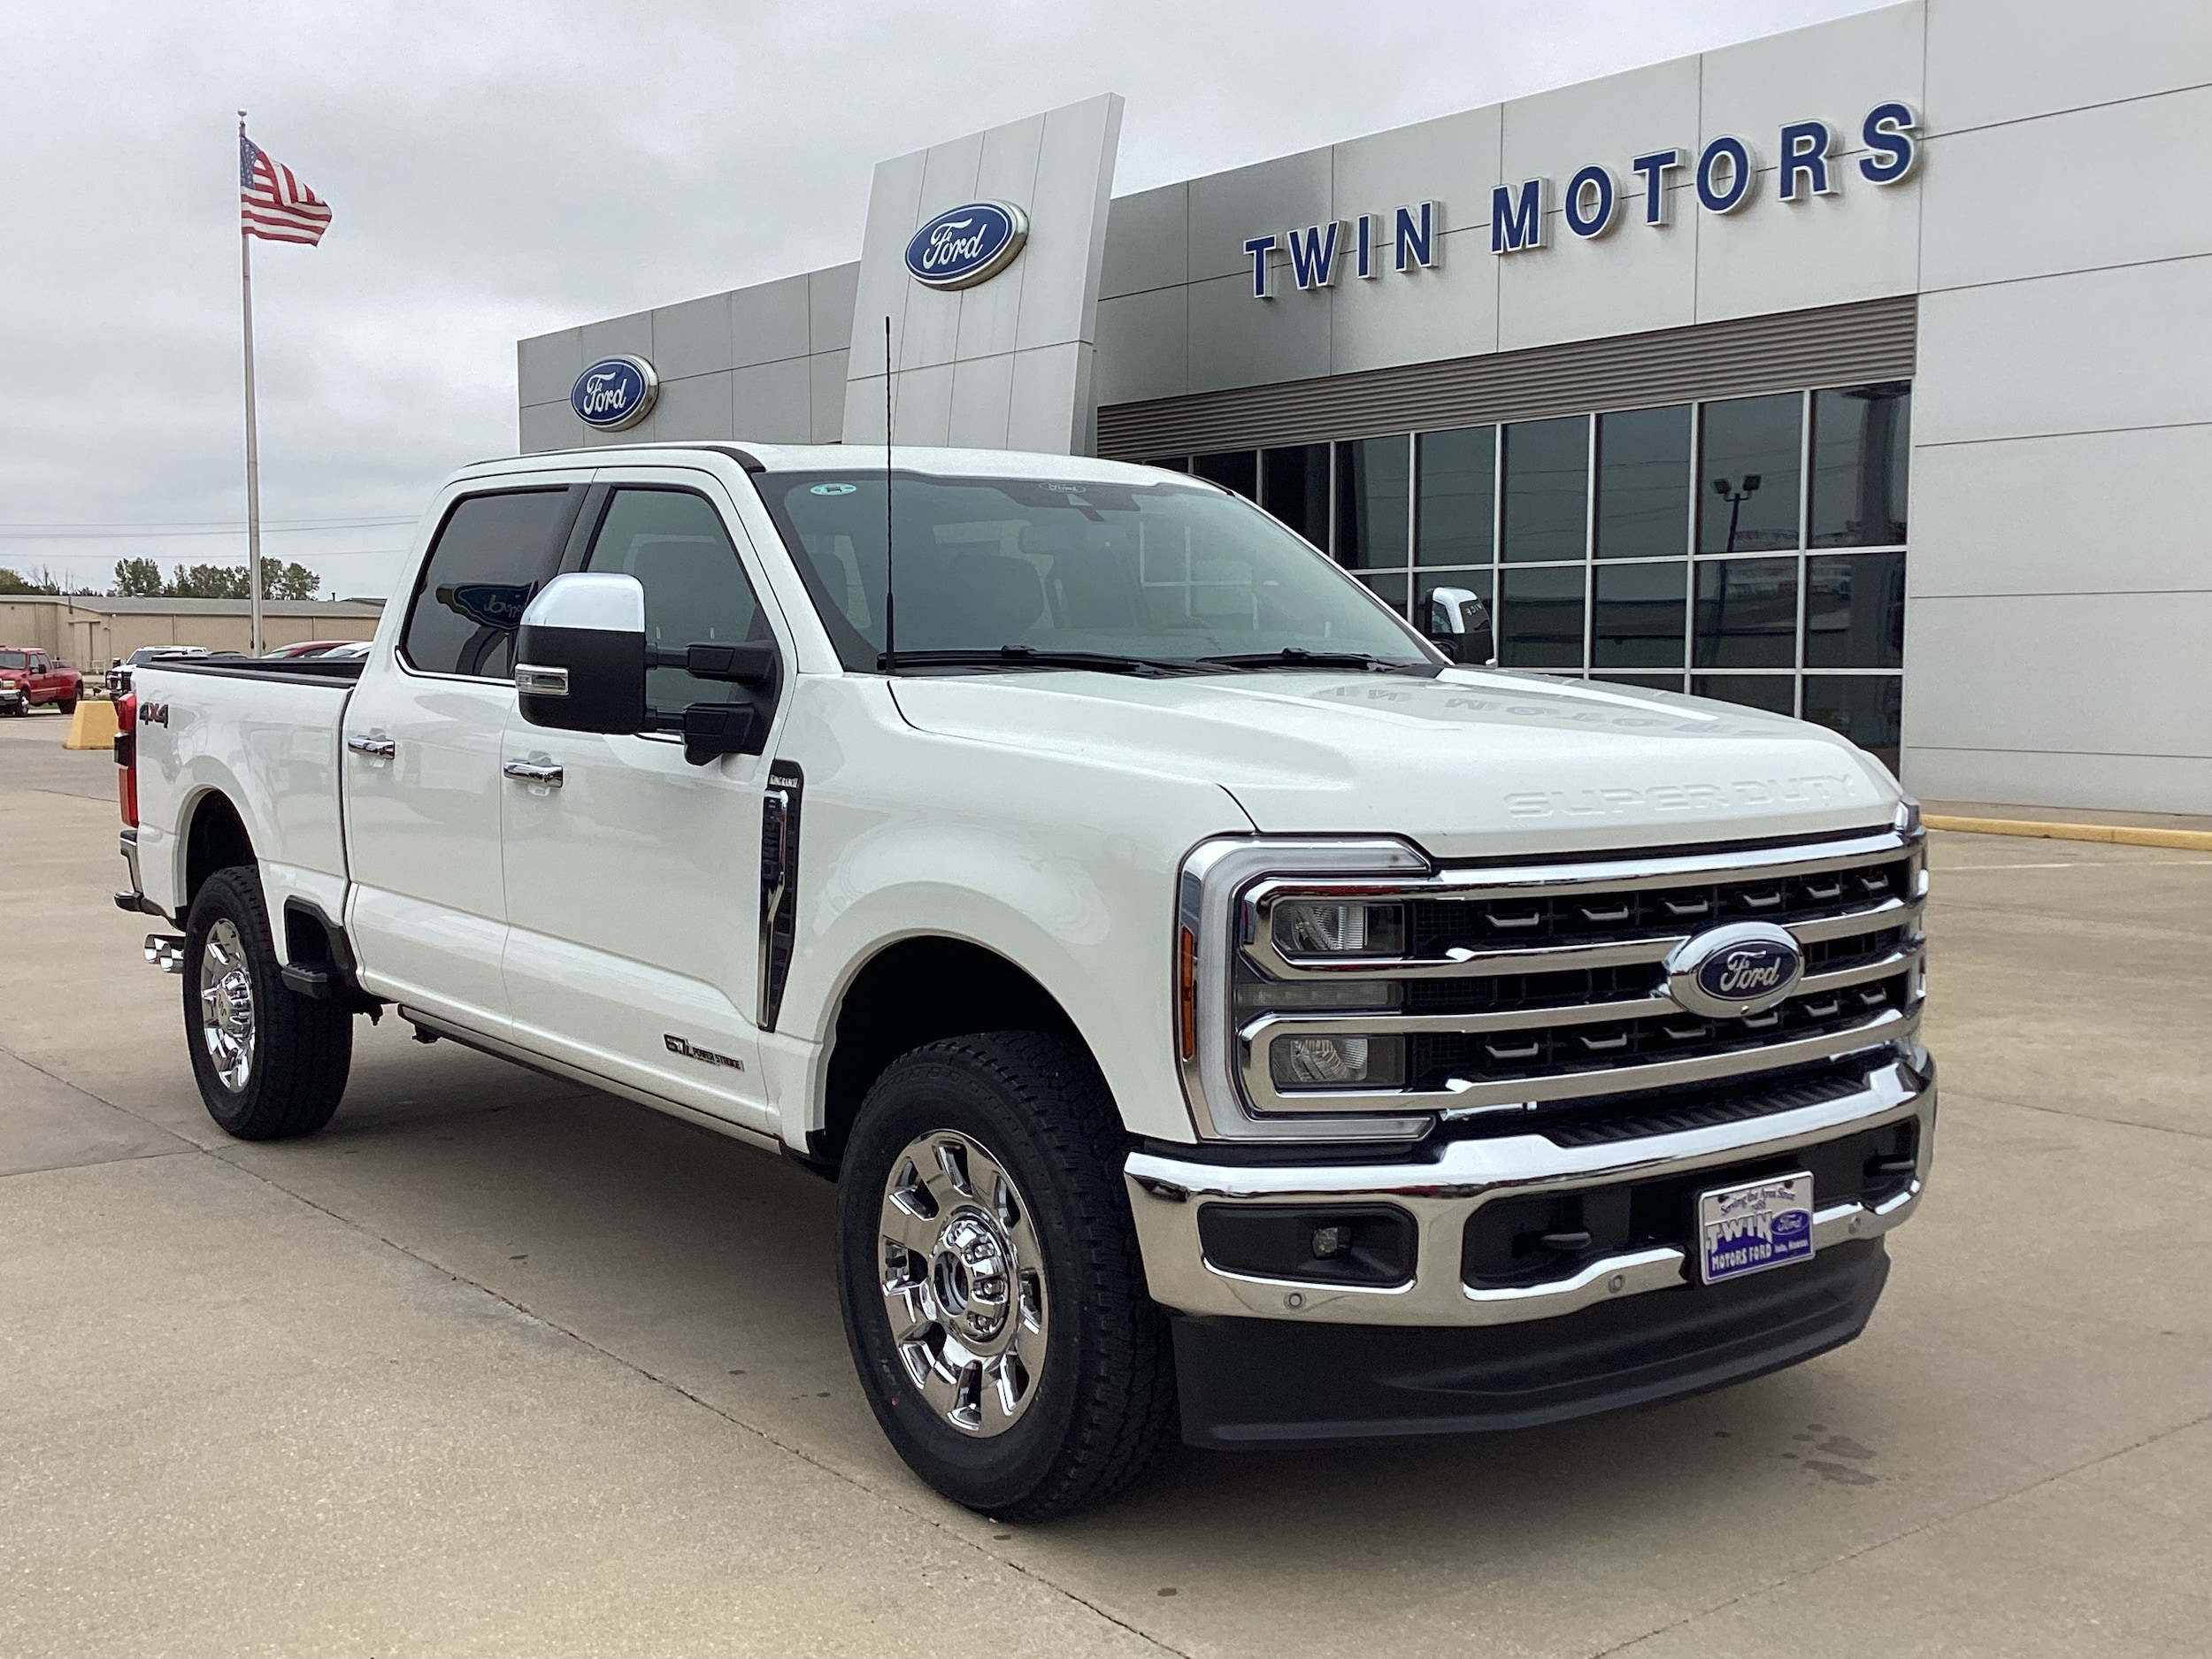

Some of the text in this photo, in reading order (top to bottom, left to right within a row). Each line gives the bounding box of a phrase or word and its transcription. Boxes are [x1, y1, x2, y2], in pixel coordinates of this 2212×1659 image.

[1243, 100, 1923, 299] TWIN MOTORS
[923, 218, 988, 270] Ford
[583, 372, 627, 415] Ford
[1504, 773, 1855, 818] SUPER DUTY
[1719, 949, 1782, 992] Ford
[1706, 1211, 1803, 1254] TWIN Ford
[1711, 1244, 1772, 1271] MOTORS FORD
